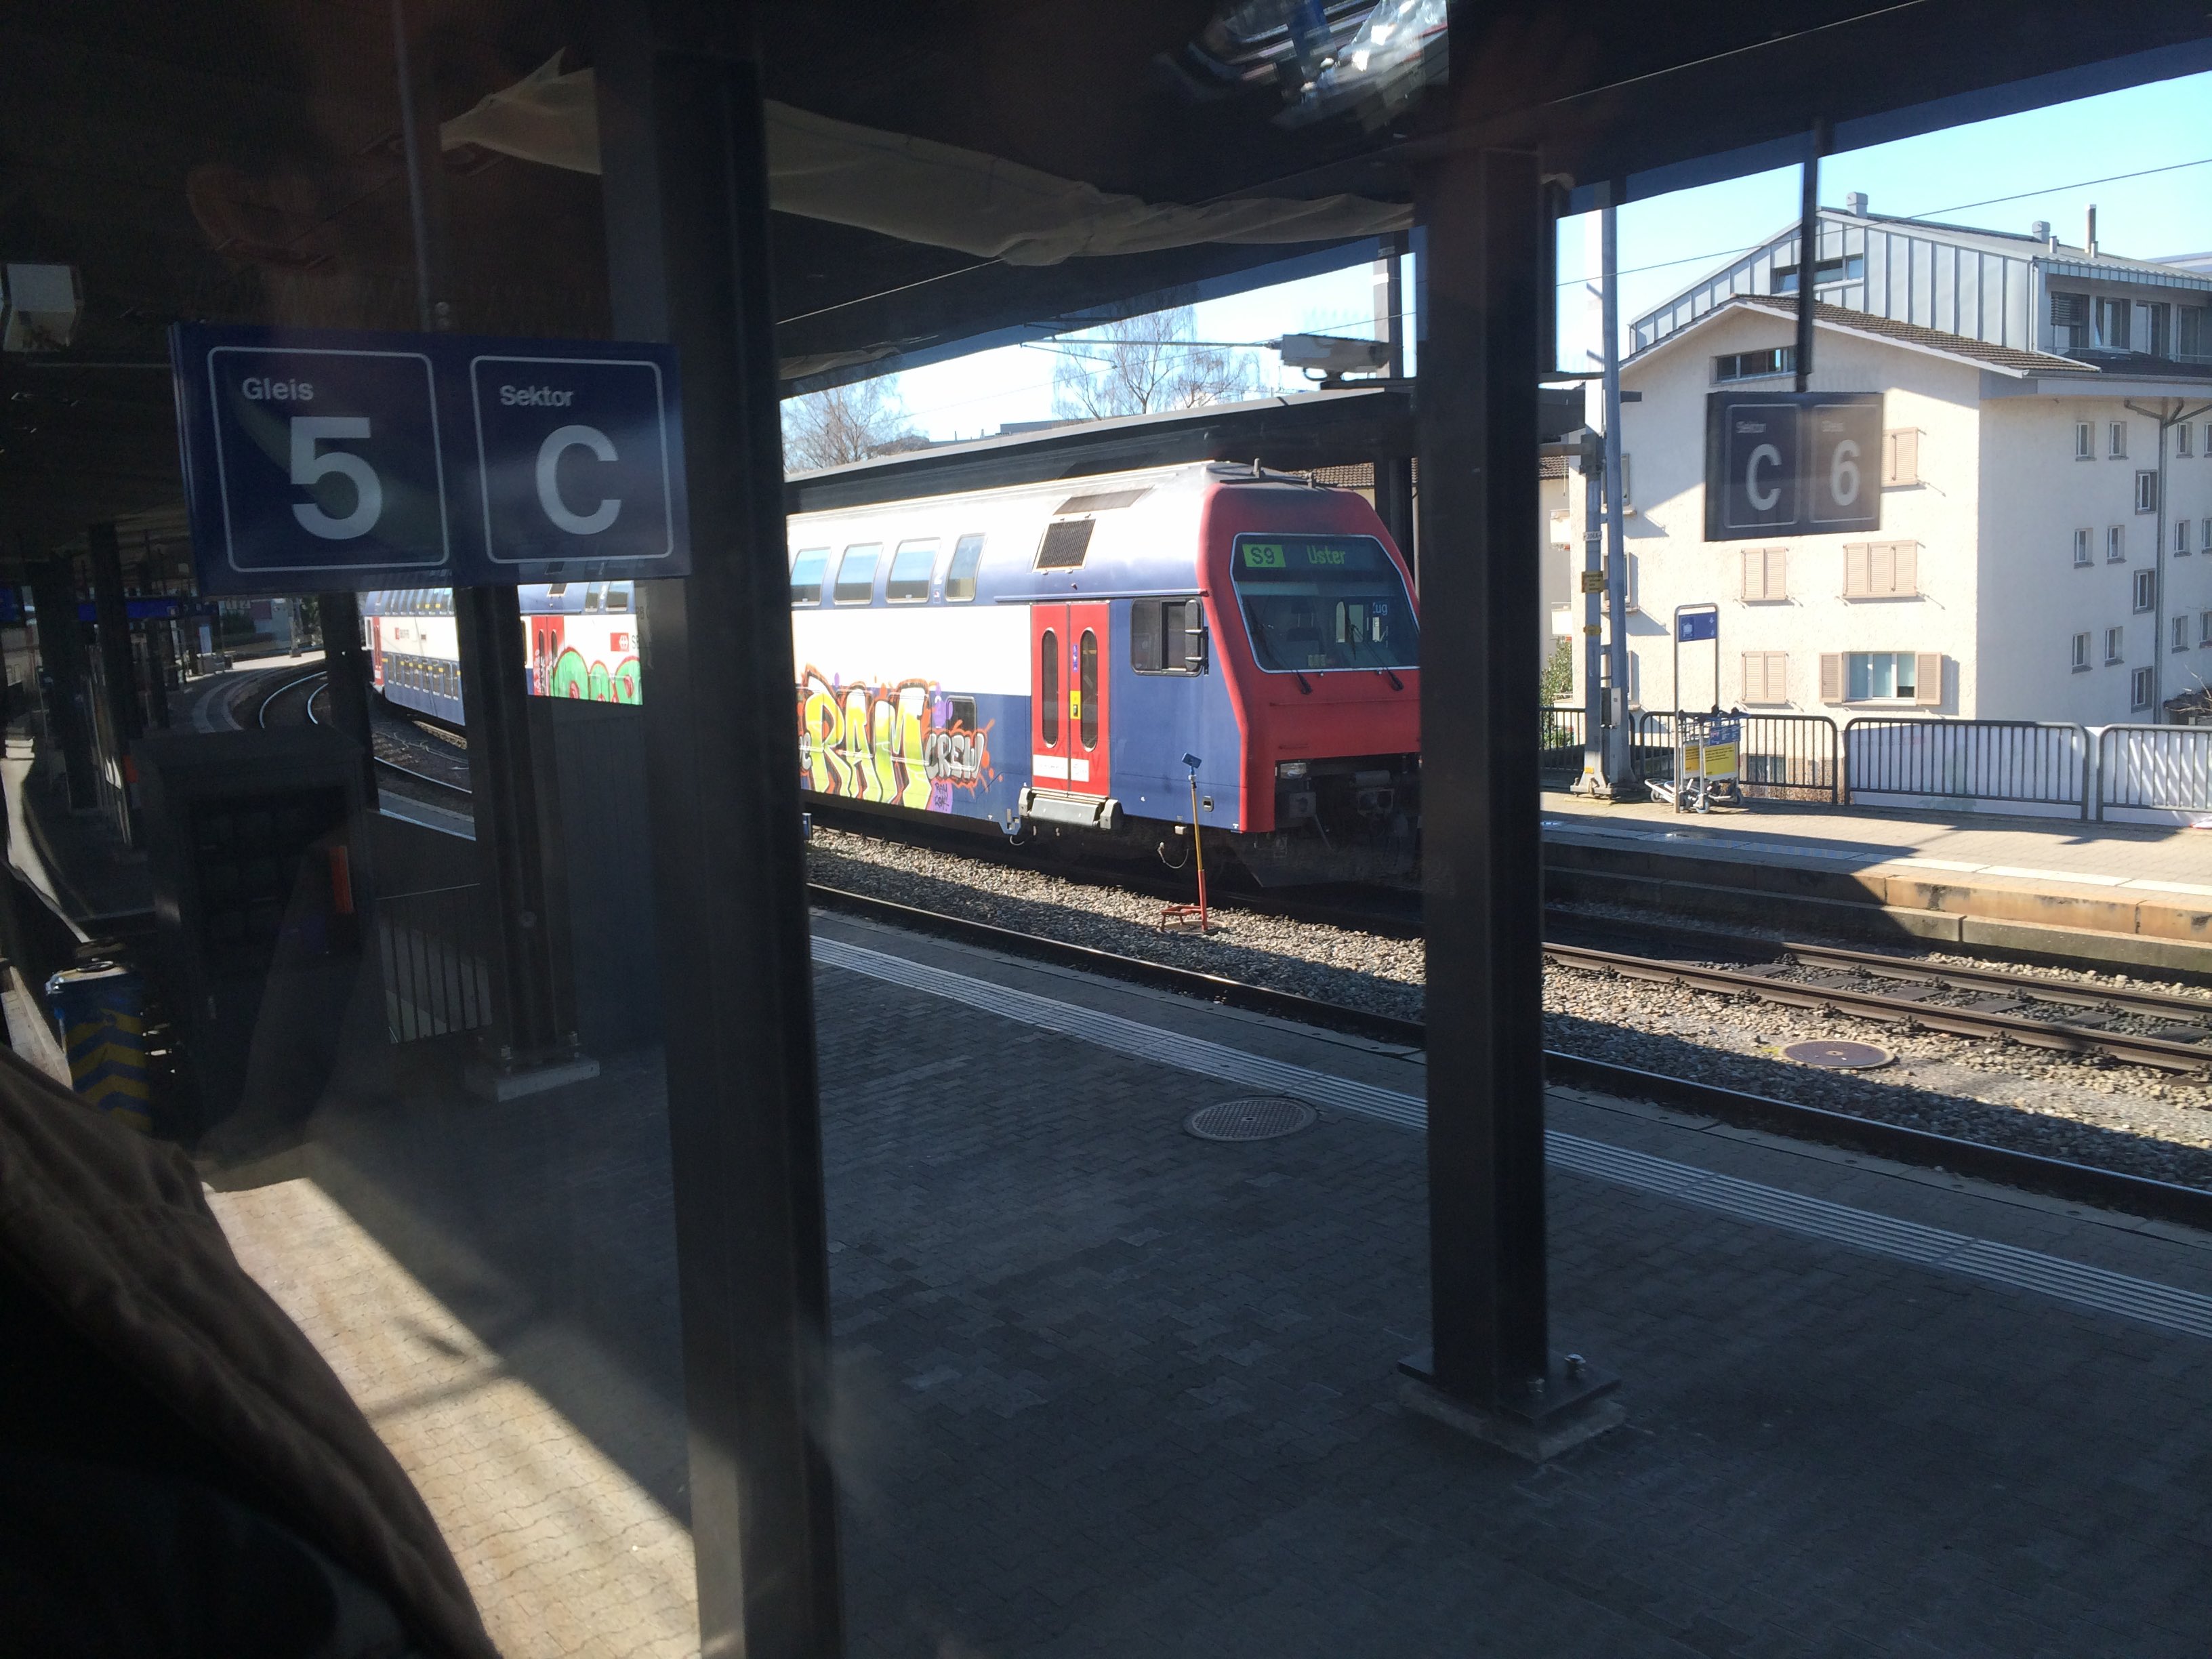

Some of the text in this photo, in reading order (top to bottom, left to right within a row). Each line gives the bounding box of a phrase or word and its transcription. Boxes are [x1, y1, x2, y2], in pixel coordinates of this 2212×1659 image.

[242, 377, 314, 401] Gleis
[499, 384, 575, 407] Sektor
[290, 415, 382, 539] 5
[535, 424, 622, 535] C
[1745, 443, 1782, 511] C
[1830, 439, 1861, 507] 6
[1250, 545, 1346, 565] S9 Uster
[804, 672, 932, 811] RAM
[924, 733, 985, 780] CREW
